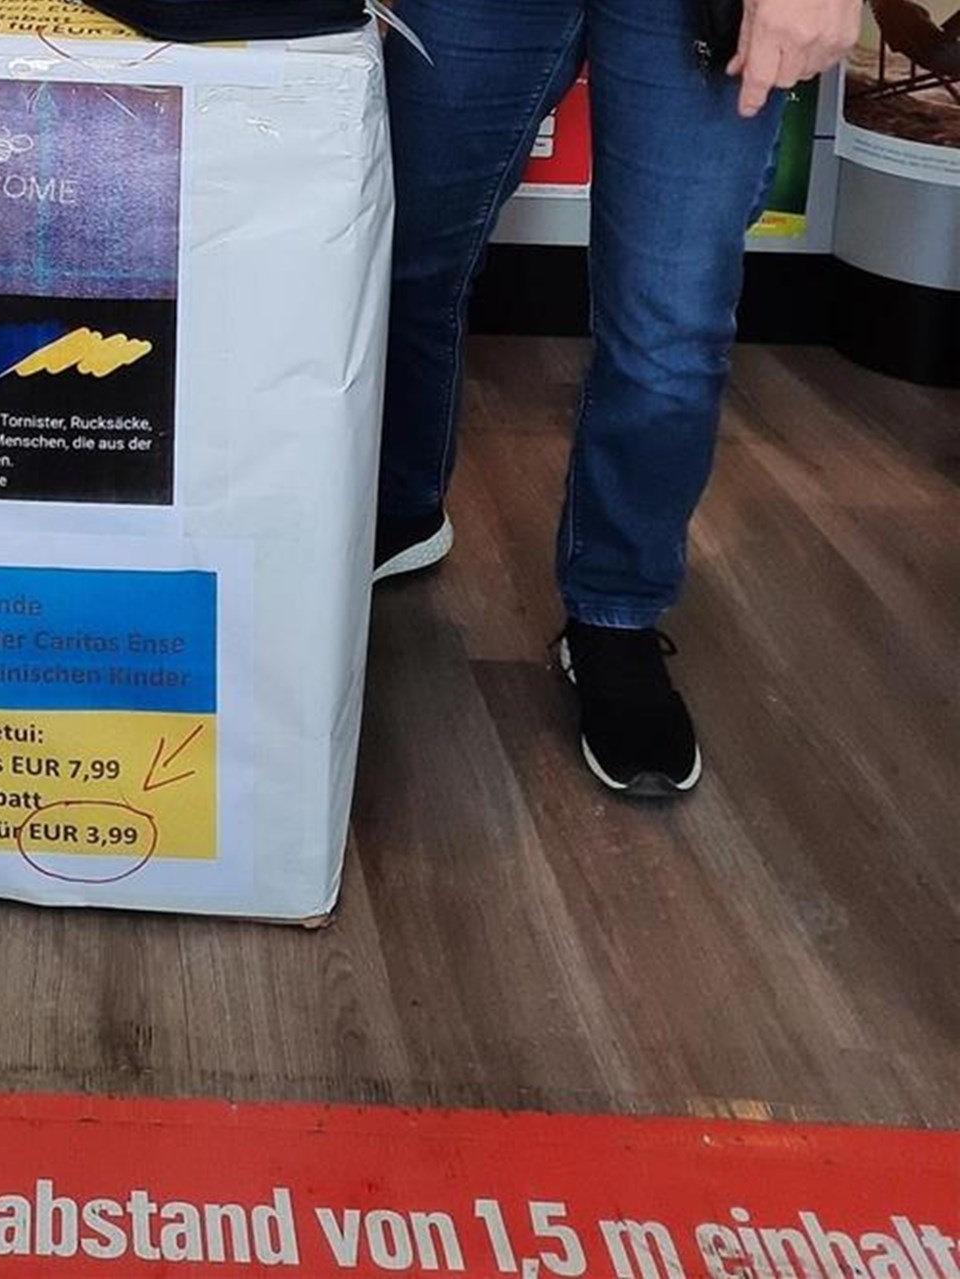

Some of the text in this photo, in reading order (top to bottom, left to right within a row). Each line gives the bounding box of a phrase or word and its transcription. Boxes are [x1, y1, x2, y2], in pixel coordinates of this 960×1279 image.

[0, 413, 67, 431] Tornister,
[70, 415, 153, 432] Rucksäcke,
[72, 435, 96, 450] die
[98, 438, 125, 451] aus
[128, 436, 153, 451] der
[34, 631, 120, 653] Caritas
[127, 634, 187, 655] Ense
[109, 666, 191, 687] Kinder
[11, 755, 61, 778] EUR
[68, 759, 121, 783] 7,99
[29, 822, 79, 843] EUR
[85, 826, 139, 848] 3,99
[314, 1206, 466, 1271] von
[474, 1198, 589, 1279] 1,5
[598, 1215, 687, 1279] m
[694, 1206, 960, 1279] einhalt
